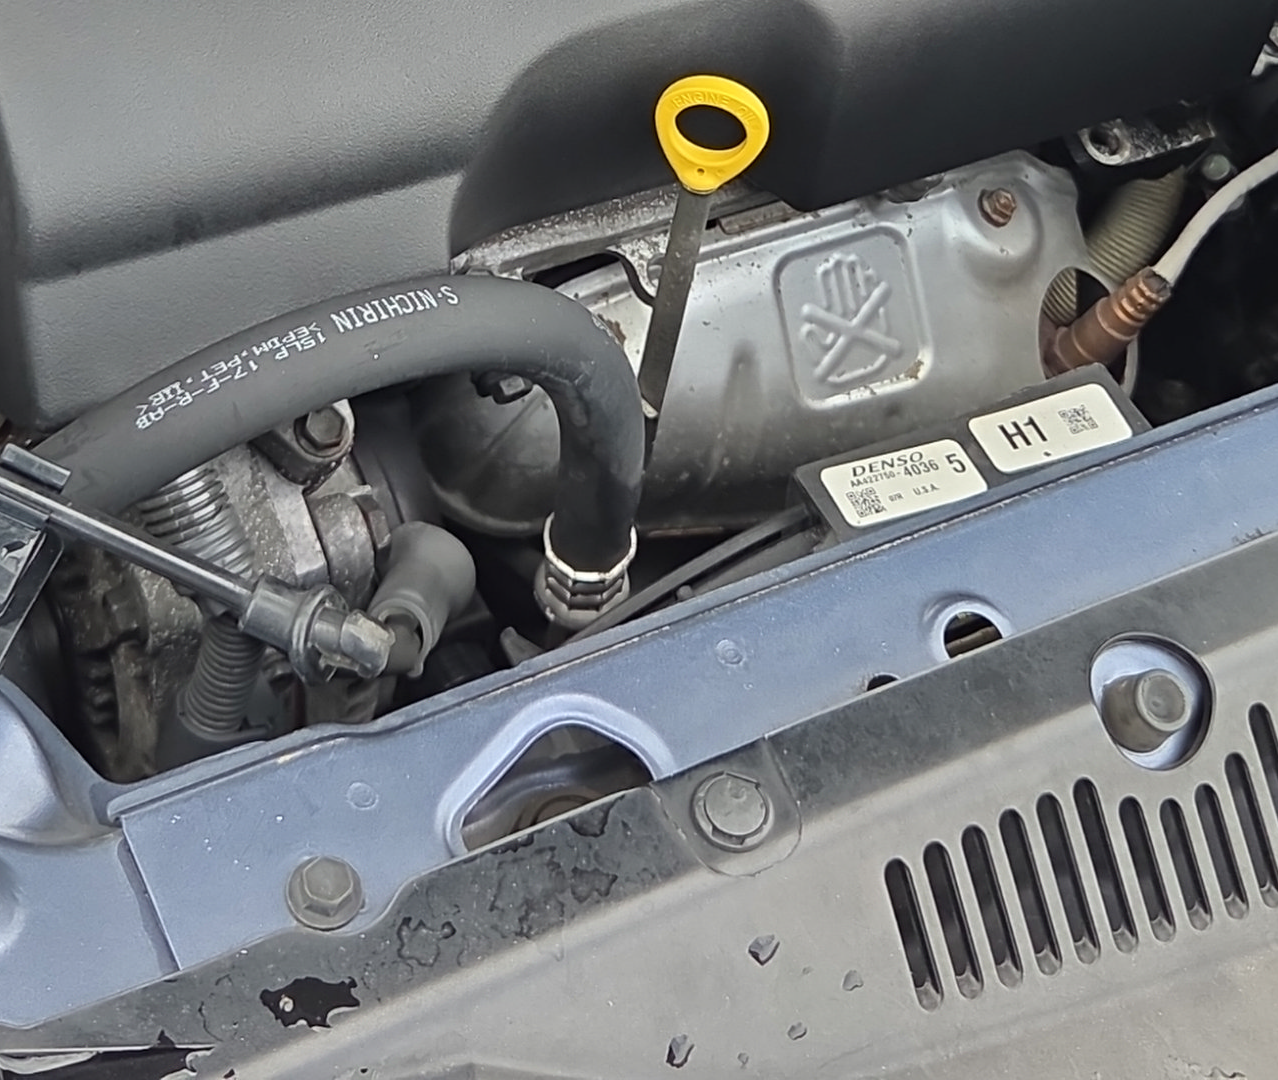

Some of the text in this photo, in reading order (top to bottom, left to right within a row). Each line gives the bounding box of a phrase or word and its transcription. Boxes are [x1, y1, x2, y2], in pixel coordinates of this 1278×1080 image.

[672, 90, 757, 126] ENGINE OIL
[998, 415, 1049, 452] H1
[852, 450, 924, 478] DENSO
[945, 453, 967, 474] 5
